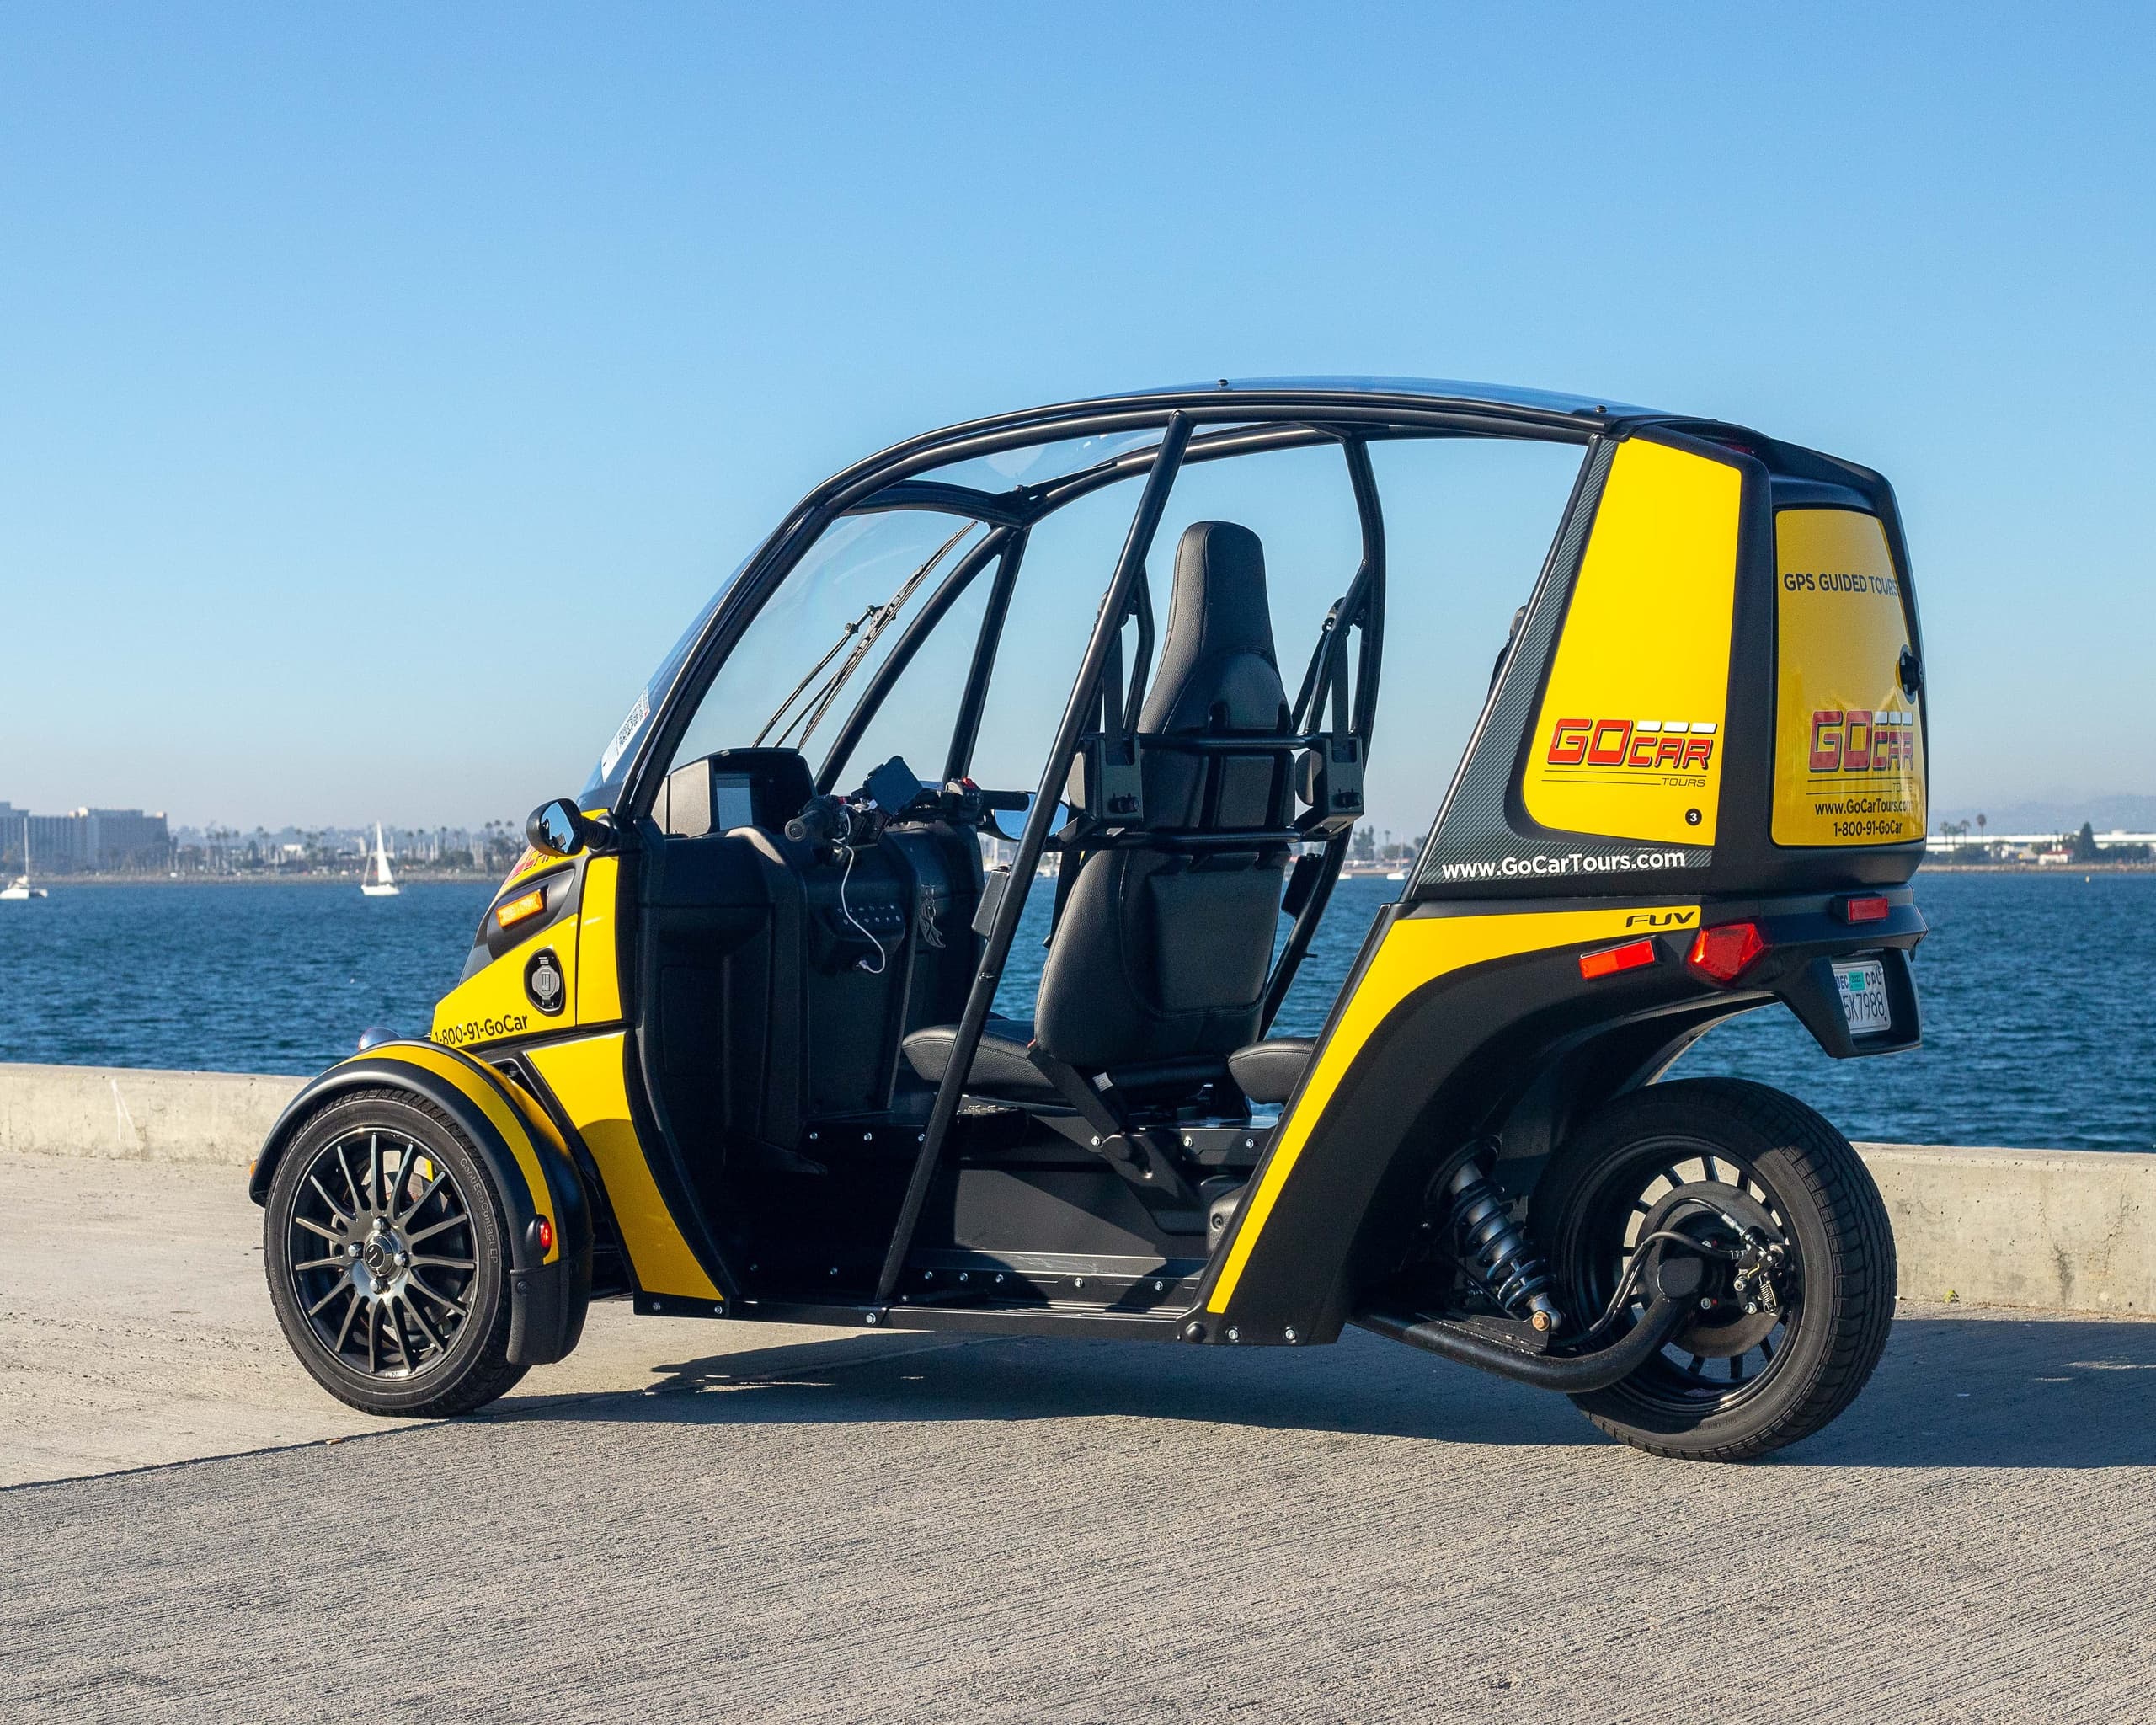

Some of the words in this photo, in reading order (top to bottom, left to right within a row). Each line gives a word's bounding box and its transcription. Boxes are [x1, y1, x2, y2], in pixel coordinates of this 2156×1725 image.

[1784, 573, 1815, 591] GPS
[1818, 573, 1867, 593] GUIDED
[1869, 575, 1899, 597] TOURS
[1662, 777, 1705, 788] TOURS
[1689, 812, 1698, 823] 3
[1833, 820, 1903, 836] 1-800-91-GoCar
[1442, 851, 1686, 879] www.GoCarTours.com
[1625, 911, 1695, 927] FUV
[435, 1014, 528, 1045] 1-800-91-GoCar
[460, 1157, 496, 1245] ContiEcoContact
[488, 1248, 499, 1263] EP
